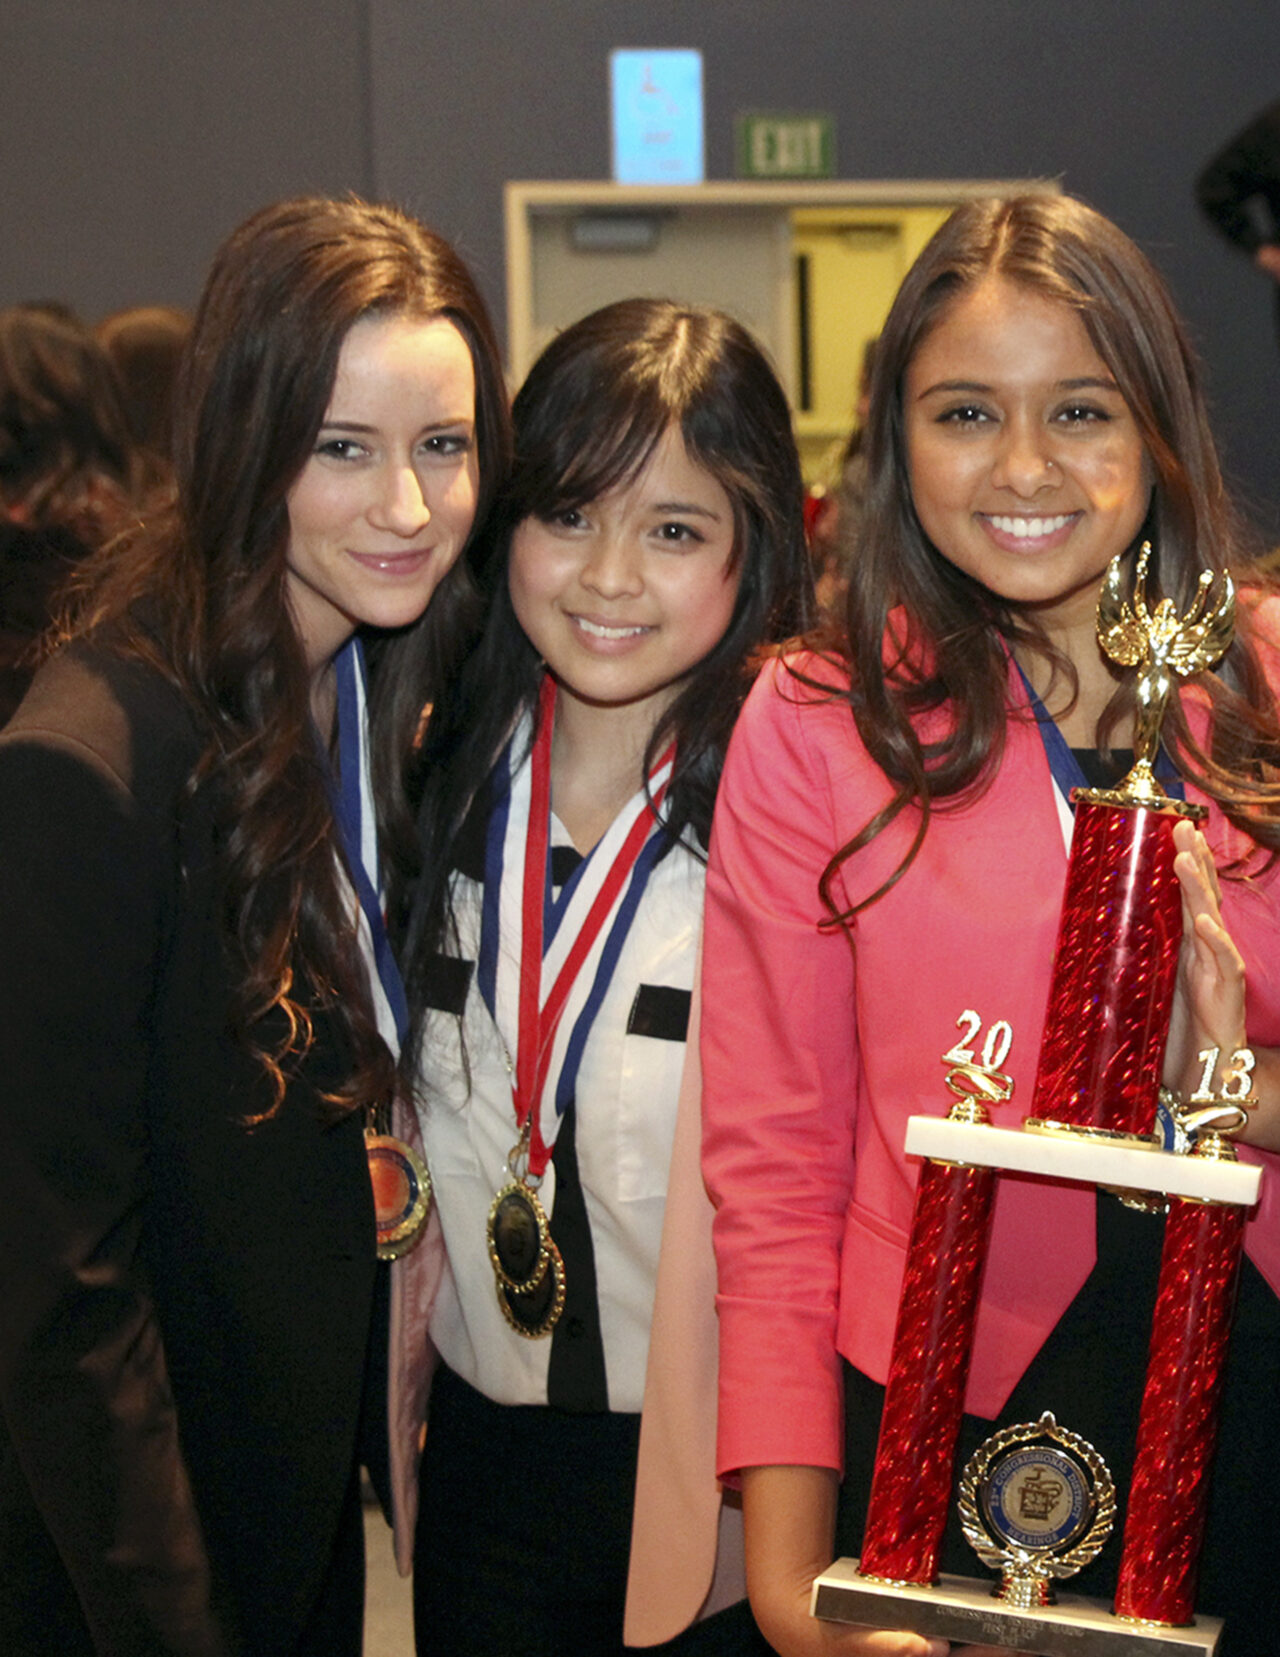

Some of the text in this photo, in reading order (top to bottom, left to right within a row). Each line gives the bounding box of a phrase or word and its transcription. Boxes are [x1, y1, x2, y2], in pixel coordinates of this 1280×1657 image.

[942, 1009, 1013, 1072] 20
[1191, 1047, 1255, 1100] 13
[995, 1453, 1068, 1486] CONGRESSIONAL
[1068, 1473, 1082, 1519] DISTRICT
